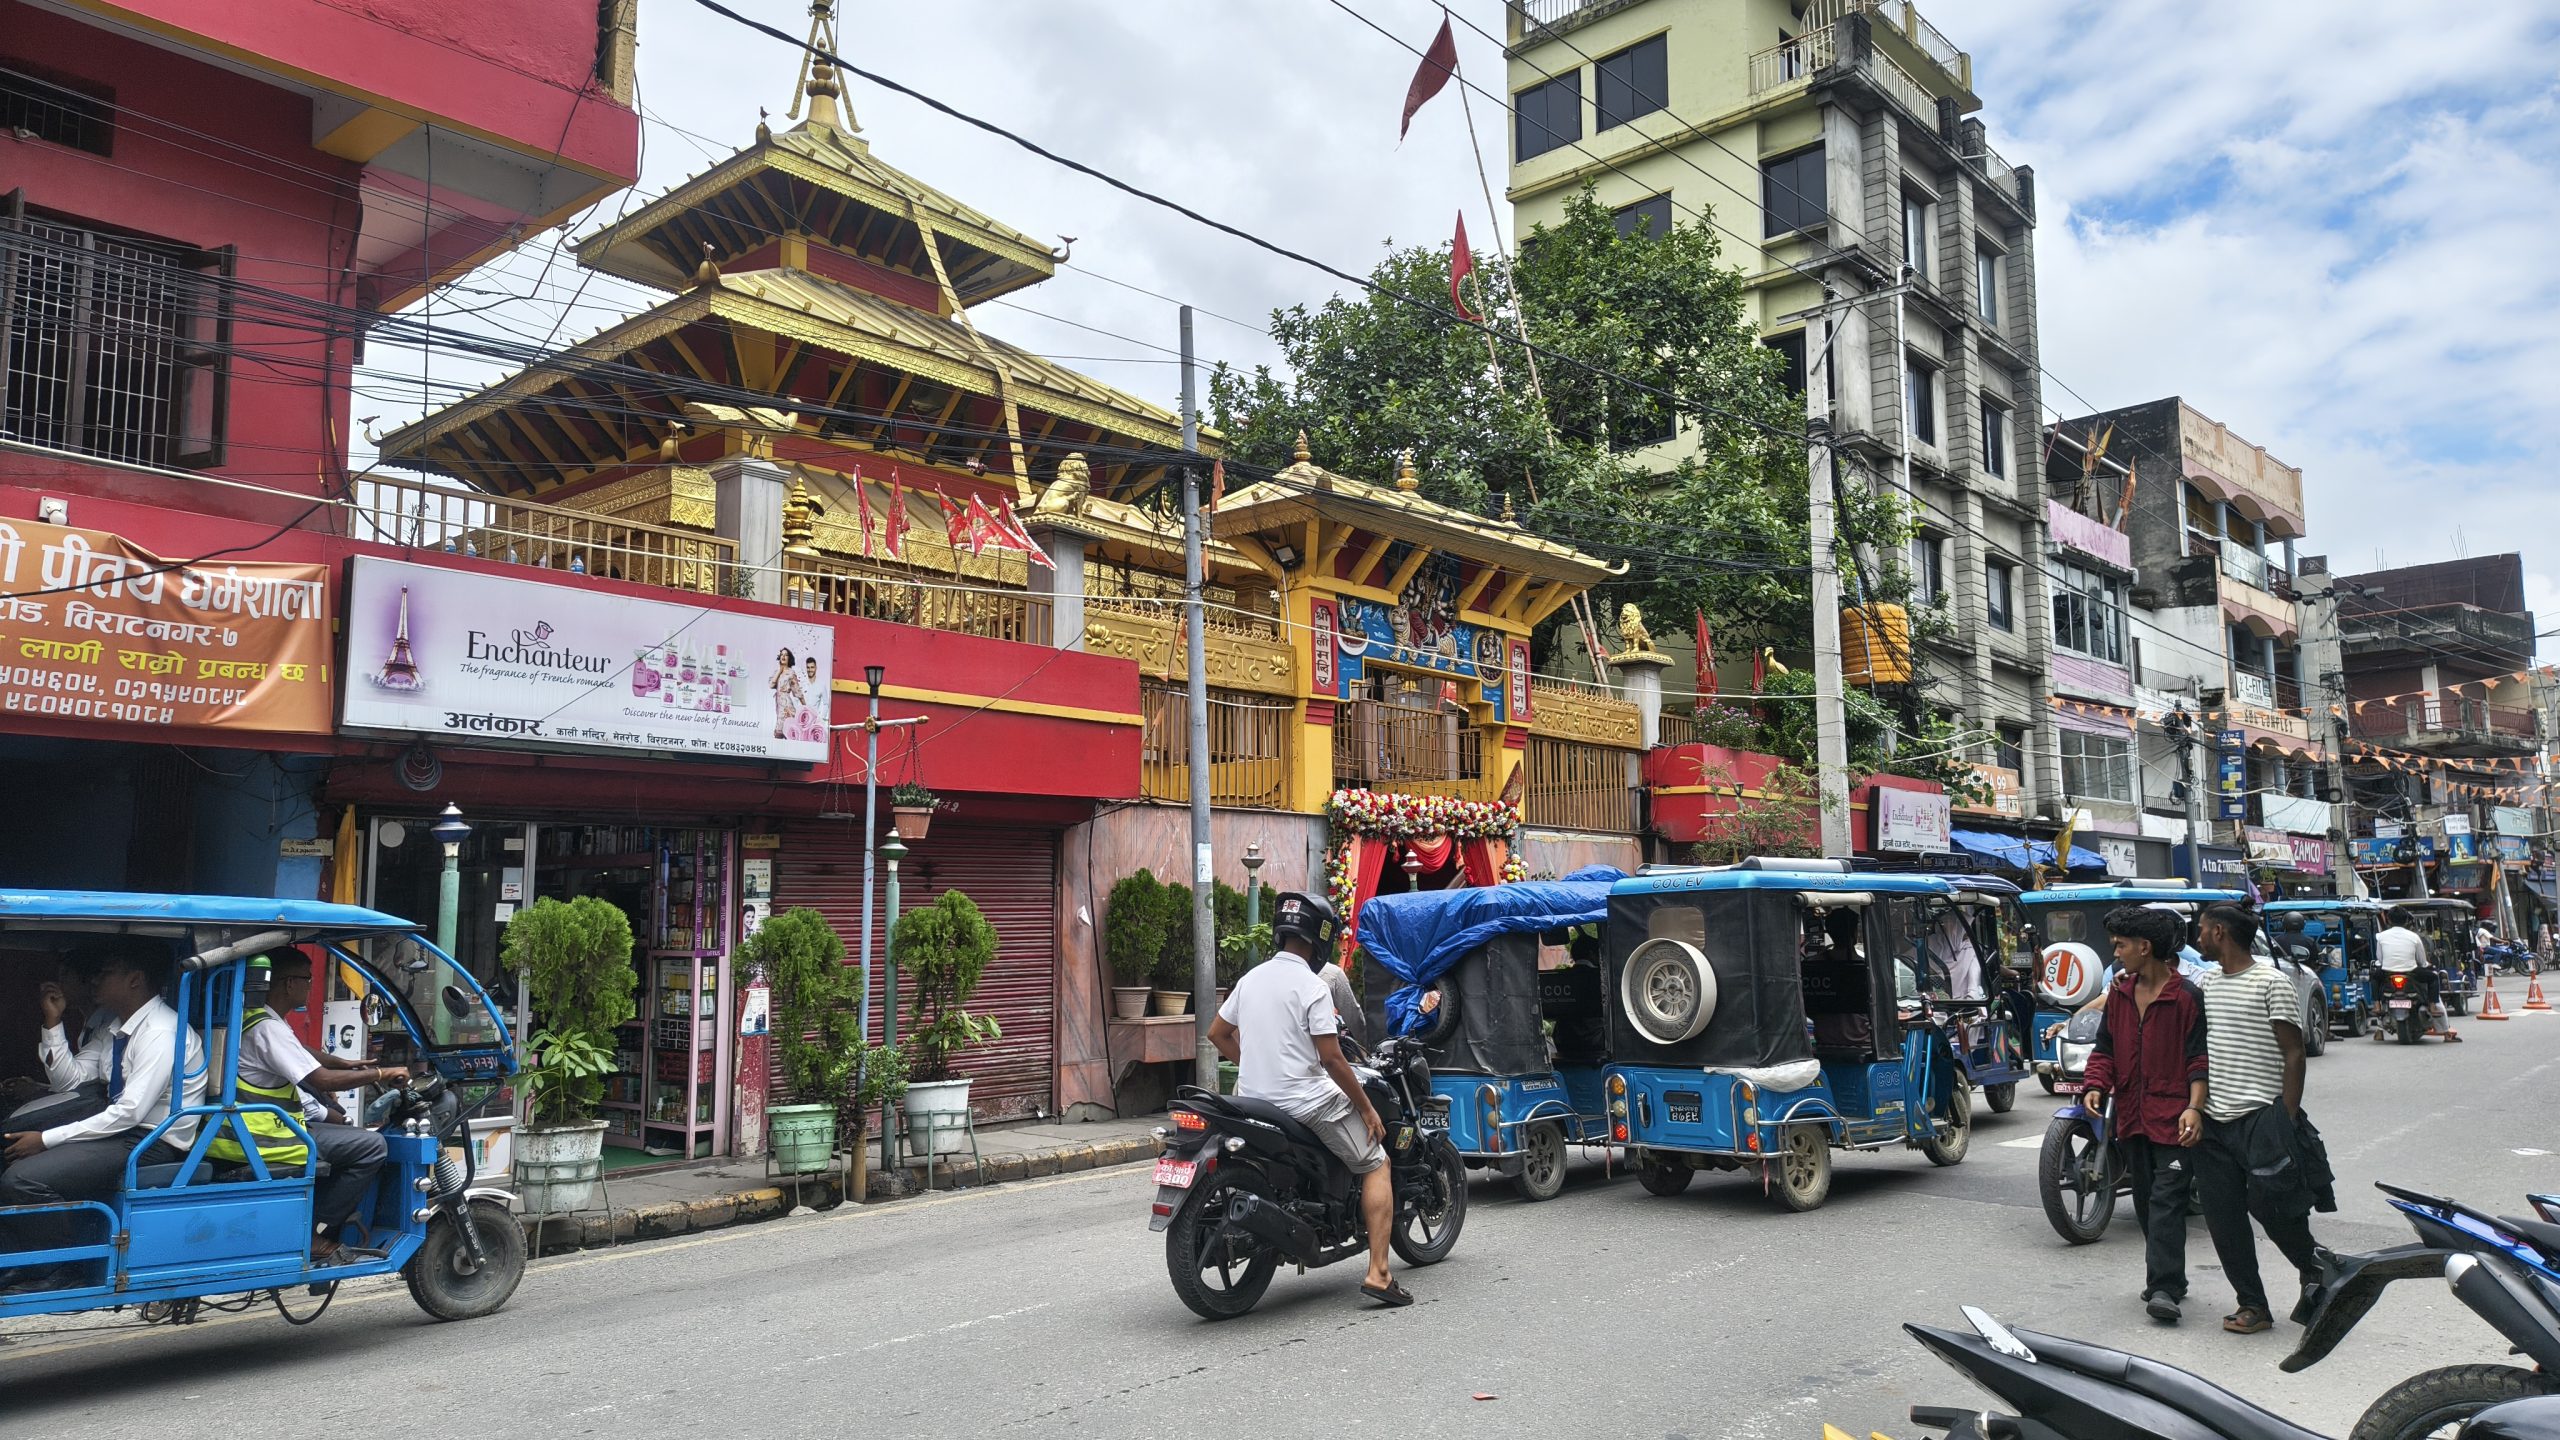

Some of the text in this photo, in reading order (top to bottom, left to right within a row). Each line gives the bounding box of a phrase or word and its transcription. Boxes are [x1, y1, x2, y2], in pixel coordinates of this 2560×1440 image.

[20, 637, 105, 665] लागी
[118, 650, 188, 675] राम्रो
[196, 659, 268, 681] प्रबन्ध
[277, 663, 309, 682] छ
[467, 629, 611, 674] Enchanteur
[460, 663, 615, 689] The fragrance of French romance
[444, 712, 548, 737] अलंकार,
[556, 727, 578, 737] काली
[582, 728, 609, 742] मन्दिर,
[647, 733, 687, 748] विराटनगर,
[623, 707, 658, 720] Discover
[660, 710, 673, 720] the
[675, 713, 693, 722] new
[694, 712, 711, 724] look
[711, 717, 721, 730] of
[1997, 776, 2007, 791] 99
[2294, 840, 2320, 863] ZAMCO
[2201, 858, 2207, 872] A
[2208, 859, 2216, 872] to
[1652, 877, 1704, 889] COC EV
[2067, 892, 2080, 900] EV
[2046, 959, 2058, 983] COC
[1877, 1071, 1900, 1087] COC
